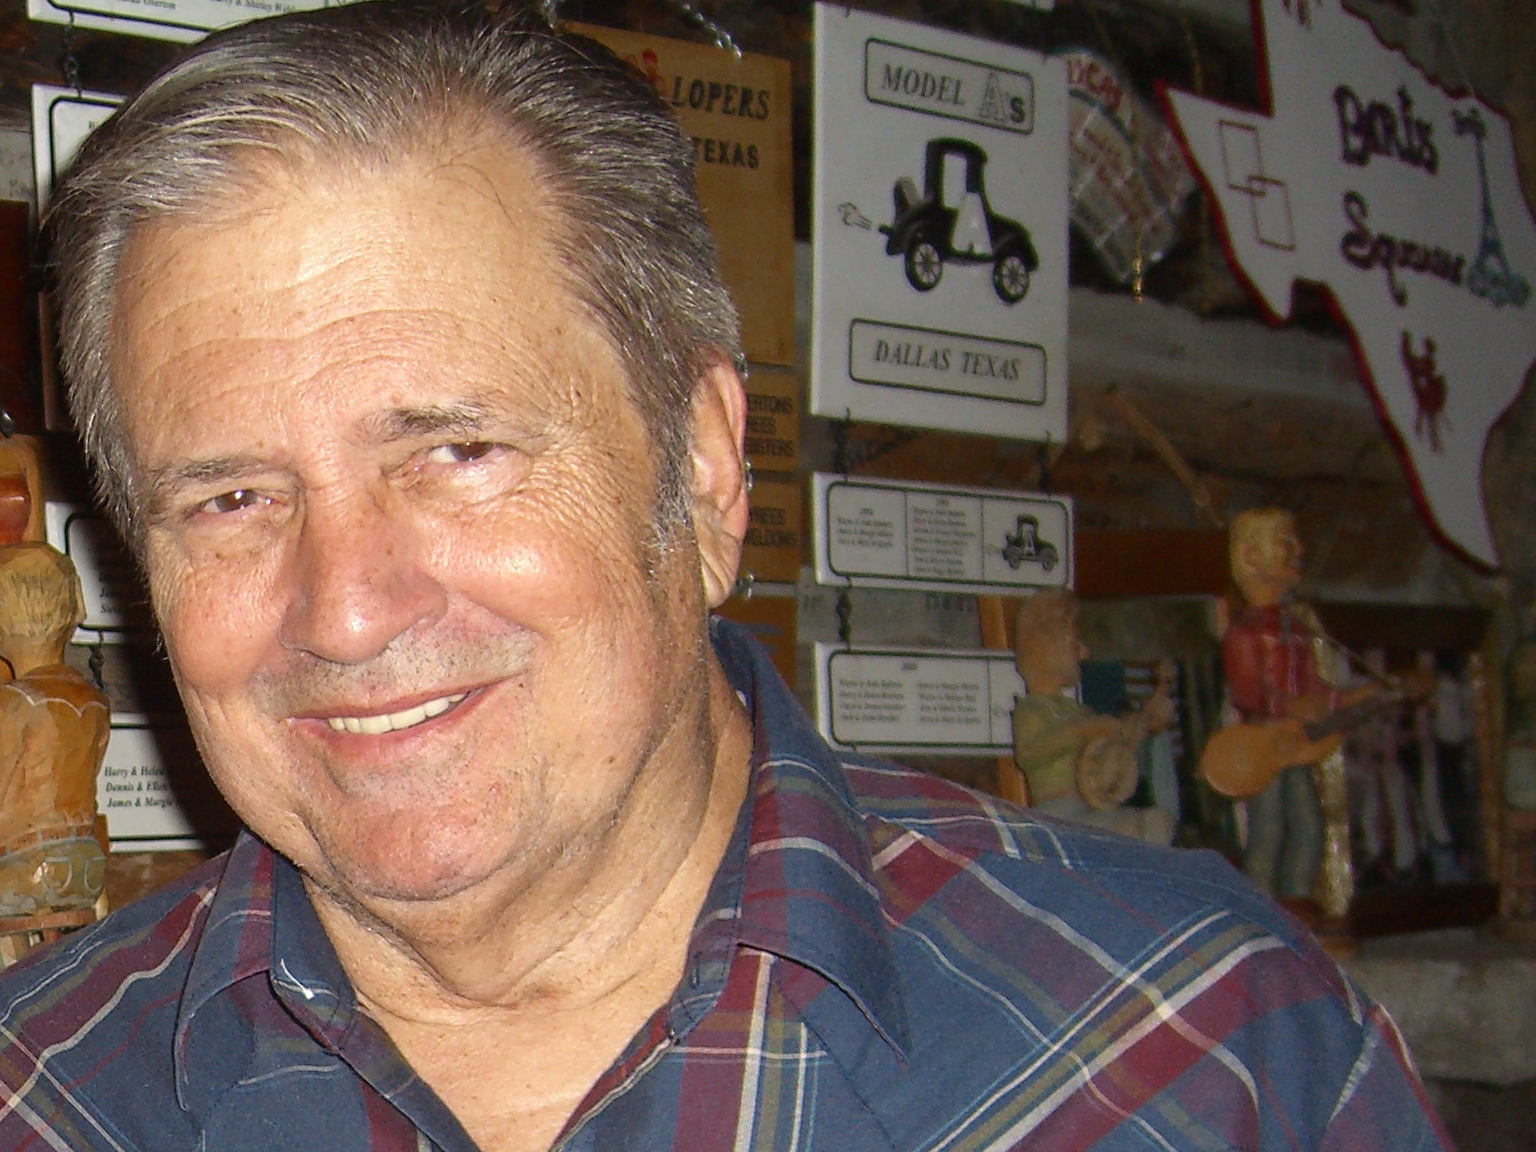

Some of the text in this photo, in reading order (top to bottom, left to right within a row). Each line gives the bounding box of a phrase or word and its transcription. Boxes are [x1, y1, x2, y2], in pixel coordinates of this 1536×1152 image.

[882, 65, 963, 104] MODEL
[873, 339, 1021, 381] DALLAS TEXAS
